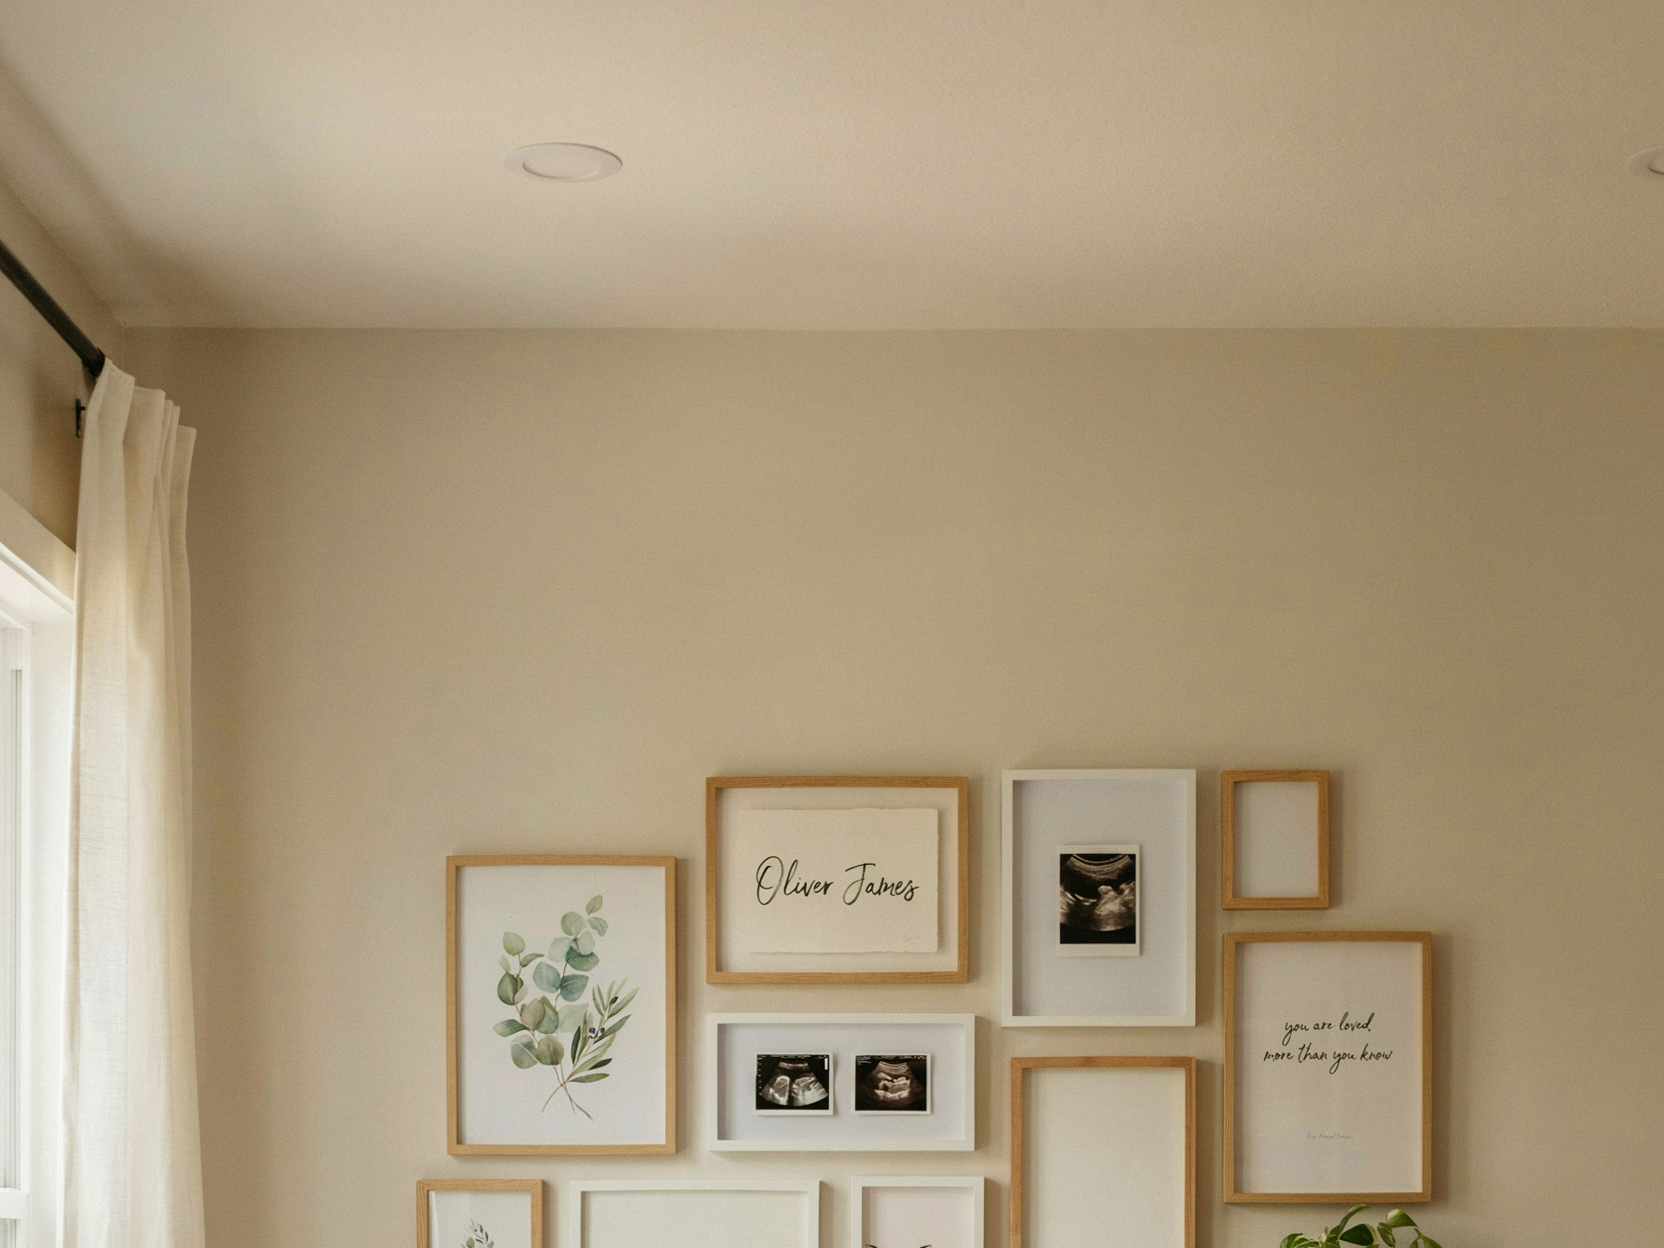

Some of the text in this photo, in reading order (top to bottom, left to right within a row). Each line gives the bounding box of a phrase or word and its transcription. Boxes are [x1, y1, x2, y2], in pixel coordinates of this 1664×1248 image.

[755, 855, 920, 906] Oliver James
[1281, 1021, 1309, 1047] you
[1313, 1021, 1335, 1031] are
[1263, 1042, 1393, 1075] more than you know
